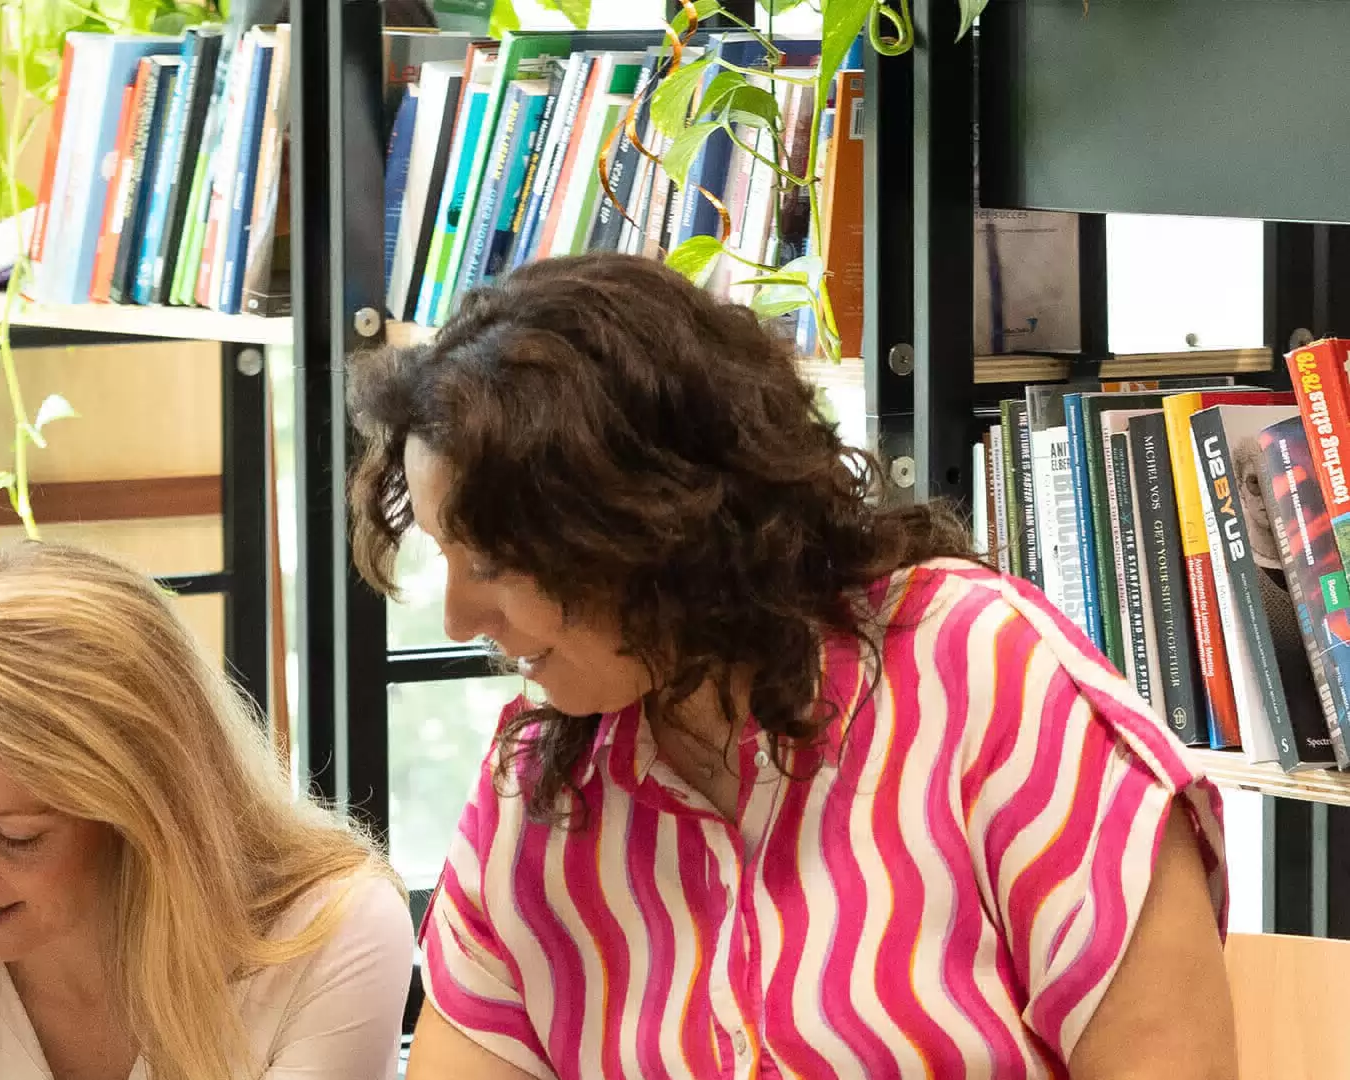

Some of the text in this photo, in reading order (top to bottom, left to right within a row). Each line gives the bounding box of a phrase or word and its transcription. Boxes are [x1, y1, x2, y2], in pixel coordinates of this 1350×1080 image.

[1309, 391, 1333, 435] atlas
[1051, 441, 1068, 457] ANI
[1144, 435, 1160, 510] MICHEL VOS
[1319, 435, 1349, 505] touring
[1018, 411, 1037, 573] THE FUTURE IS FASTER THAN YOU THINK
[1124, 530, 1134, 548] THE
[1128, 554, 1141, 608] STARFISH
[1194, 557, 1205, 599] Assessment
[1327, 579, 1338, 605] Boom
[1154, 520, 1180, 687] GET YOUR SHIT TOGETHER
[1133, 614, 1143, 633] AND
[1200, 611, 1210, 645] Learning:
[1136, 639, 1146, 659] THE
[1204, 646, 1214, 677] Meeting
